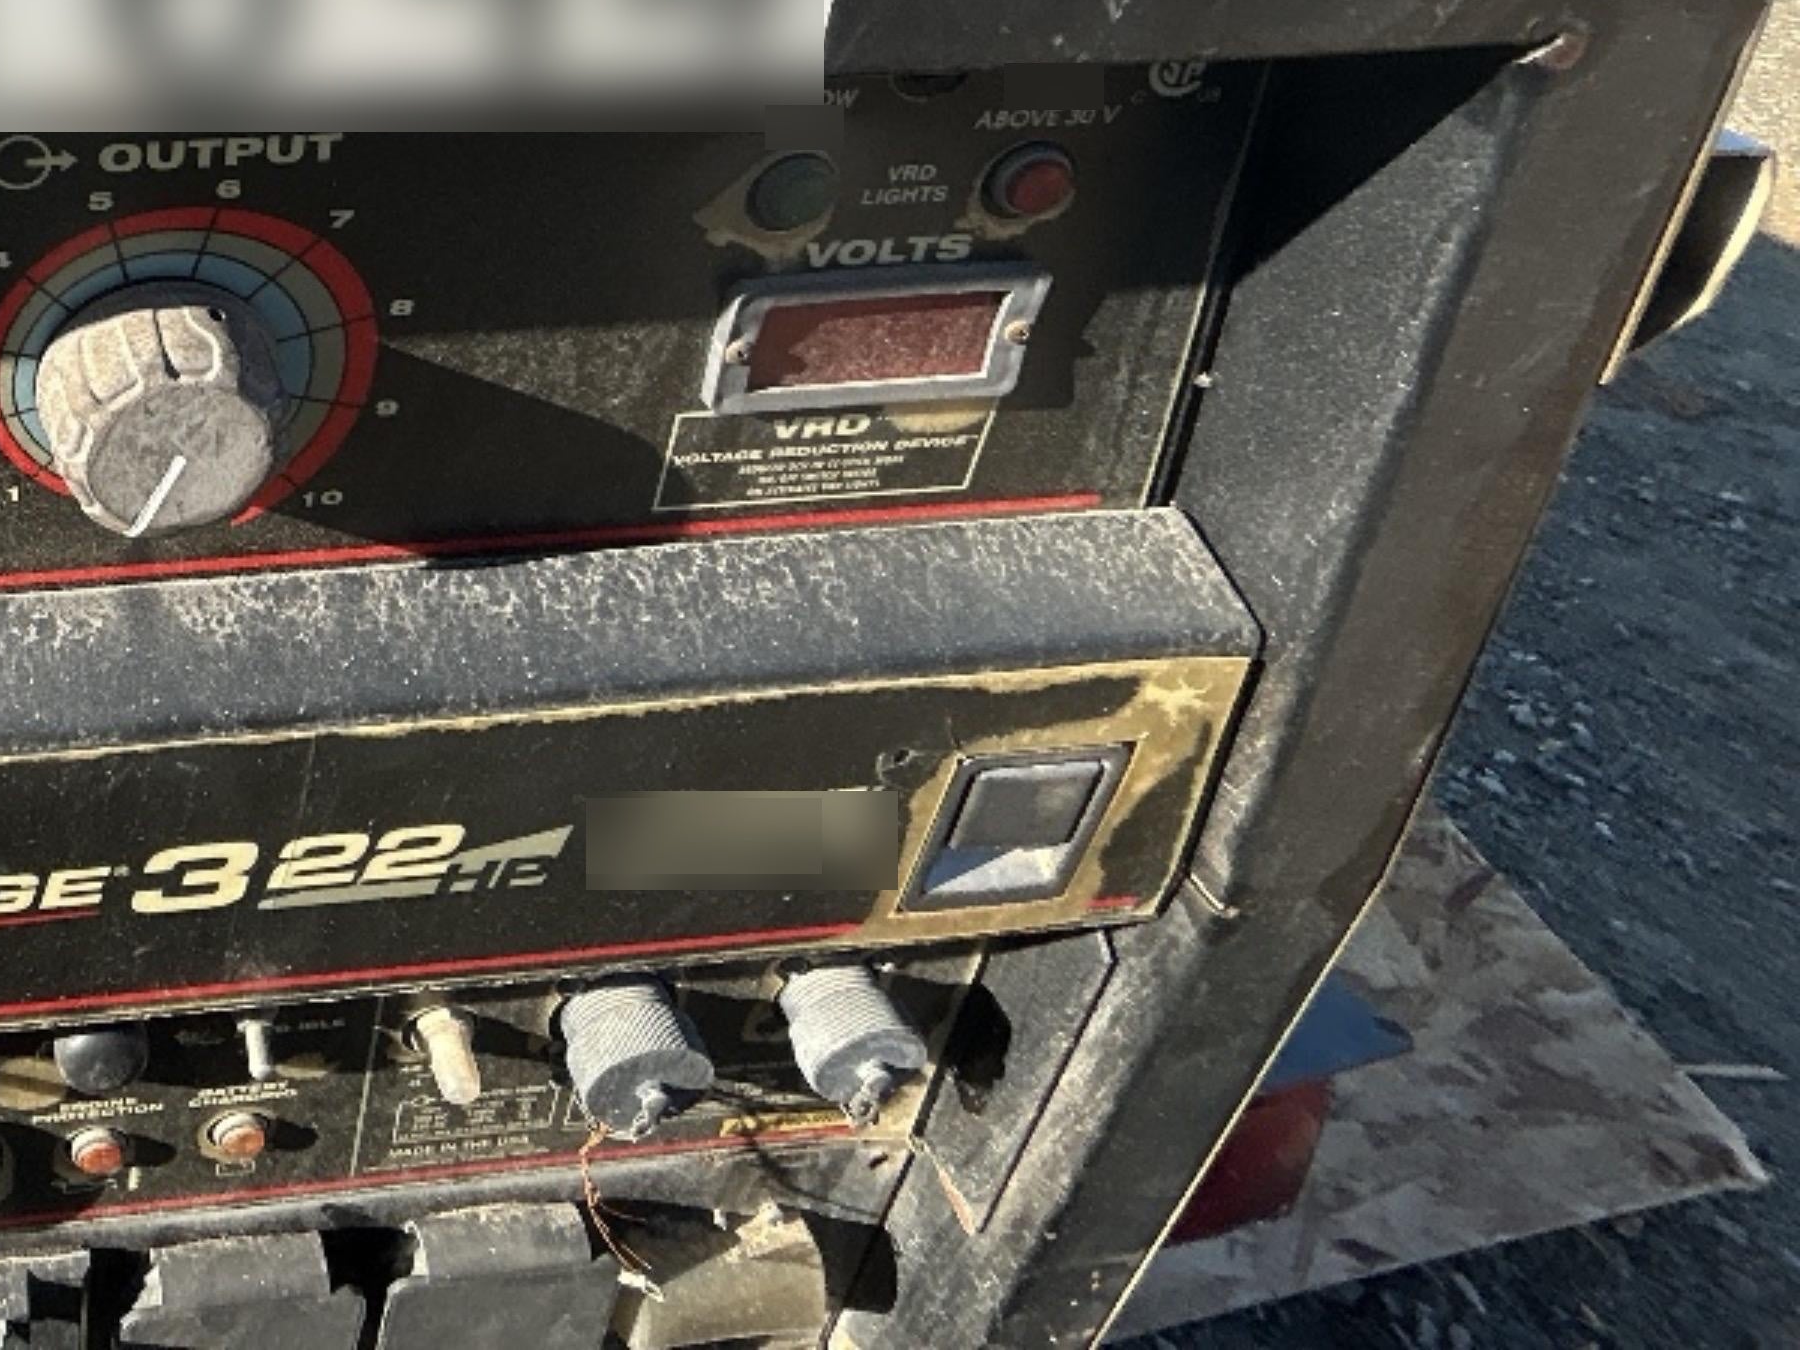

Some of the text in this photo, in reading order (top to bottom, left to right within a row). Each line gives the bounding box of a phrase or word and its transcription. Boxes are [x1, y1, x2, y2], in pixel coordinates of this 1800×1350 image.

[974, 104, 1123, 130] ABOVE 30 V
[100, 133, 343, 173] OUTPUT
[888, 163, 938, 183] VRD
[216, 179, 241, 199] 6
[861, 184, 949, 205] LIGHTS
[89, 191, 113, 212] 5
[329, 210, 355, 229] 7
[806, 232, 974, 268] VOLTS
[389, 298, 415, 317] 8
[376, 400, 399, 417] 9
[774, 413, 872, 439] VRD
[6, 485, 20, 504] 1
[302, 488, 344, 507] 10
[130, 824, 468, 913] 322
